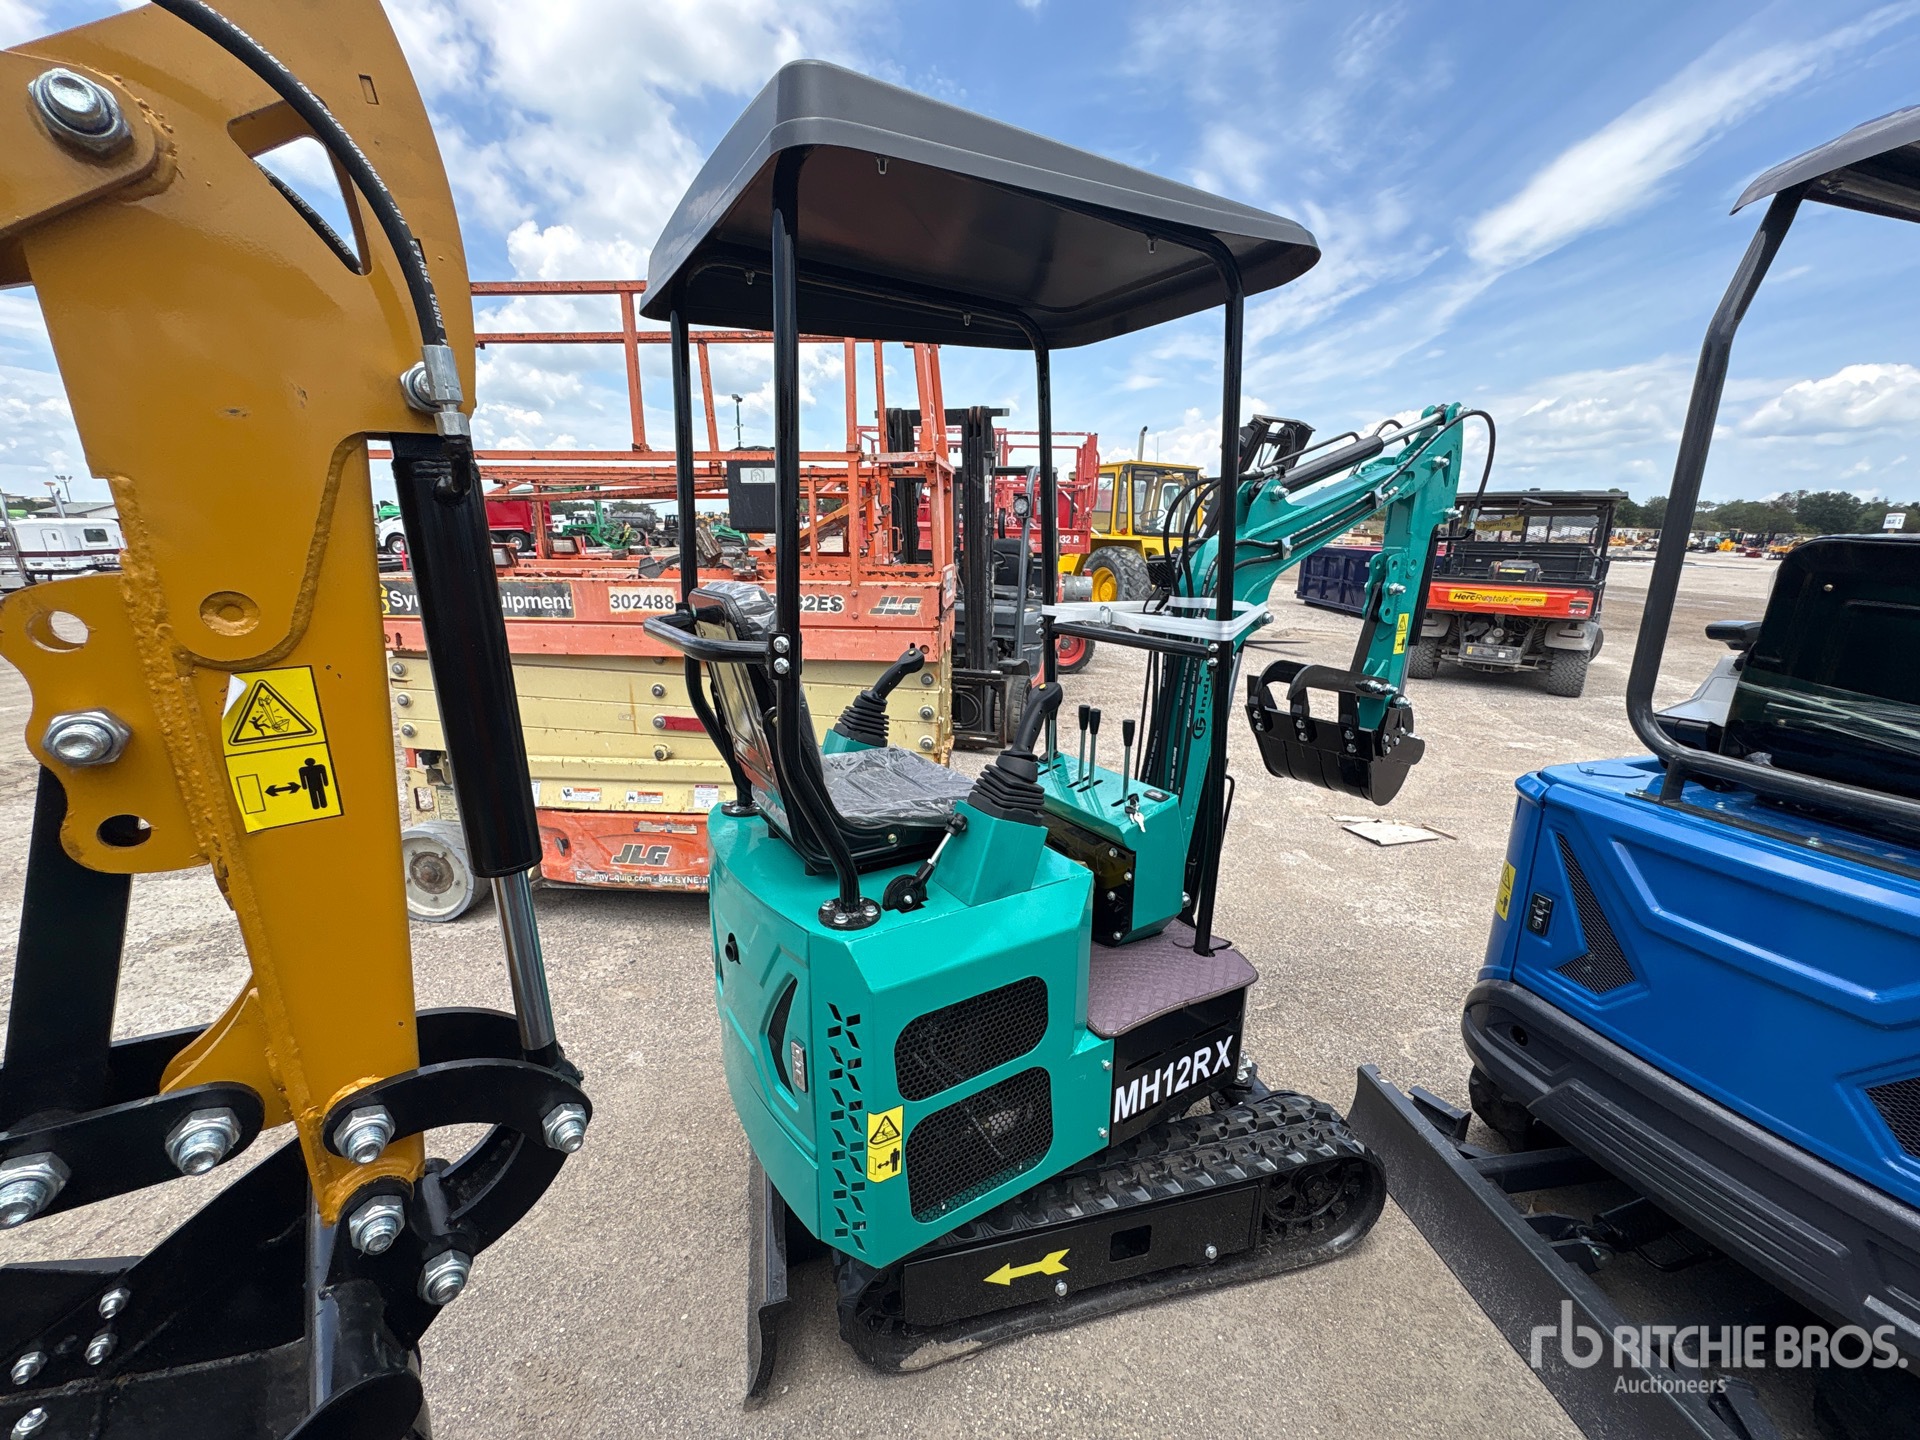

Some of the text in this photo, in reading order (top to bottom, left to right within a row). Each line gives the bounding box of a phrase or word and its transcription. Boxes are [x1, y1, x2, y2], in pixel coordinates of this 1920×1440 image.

[610, 593, 675, 610] 302488
[610, 843, 672, 867] JLG
[1113, 1034, 1234, 1124] MH12RX
